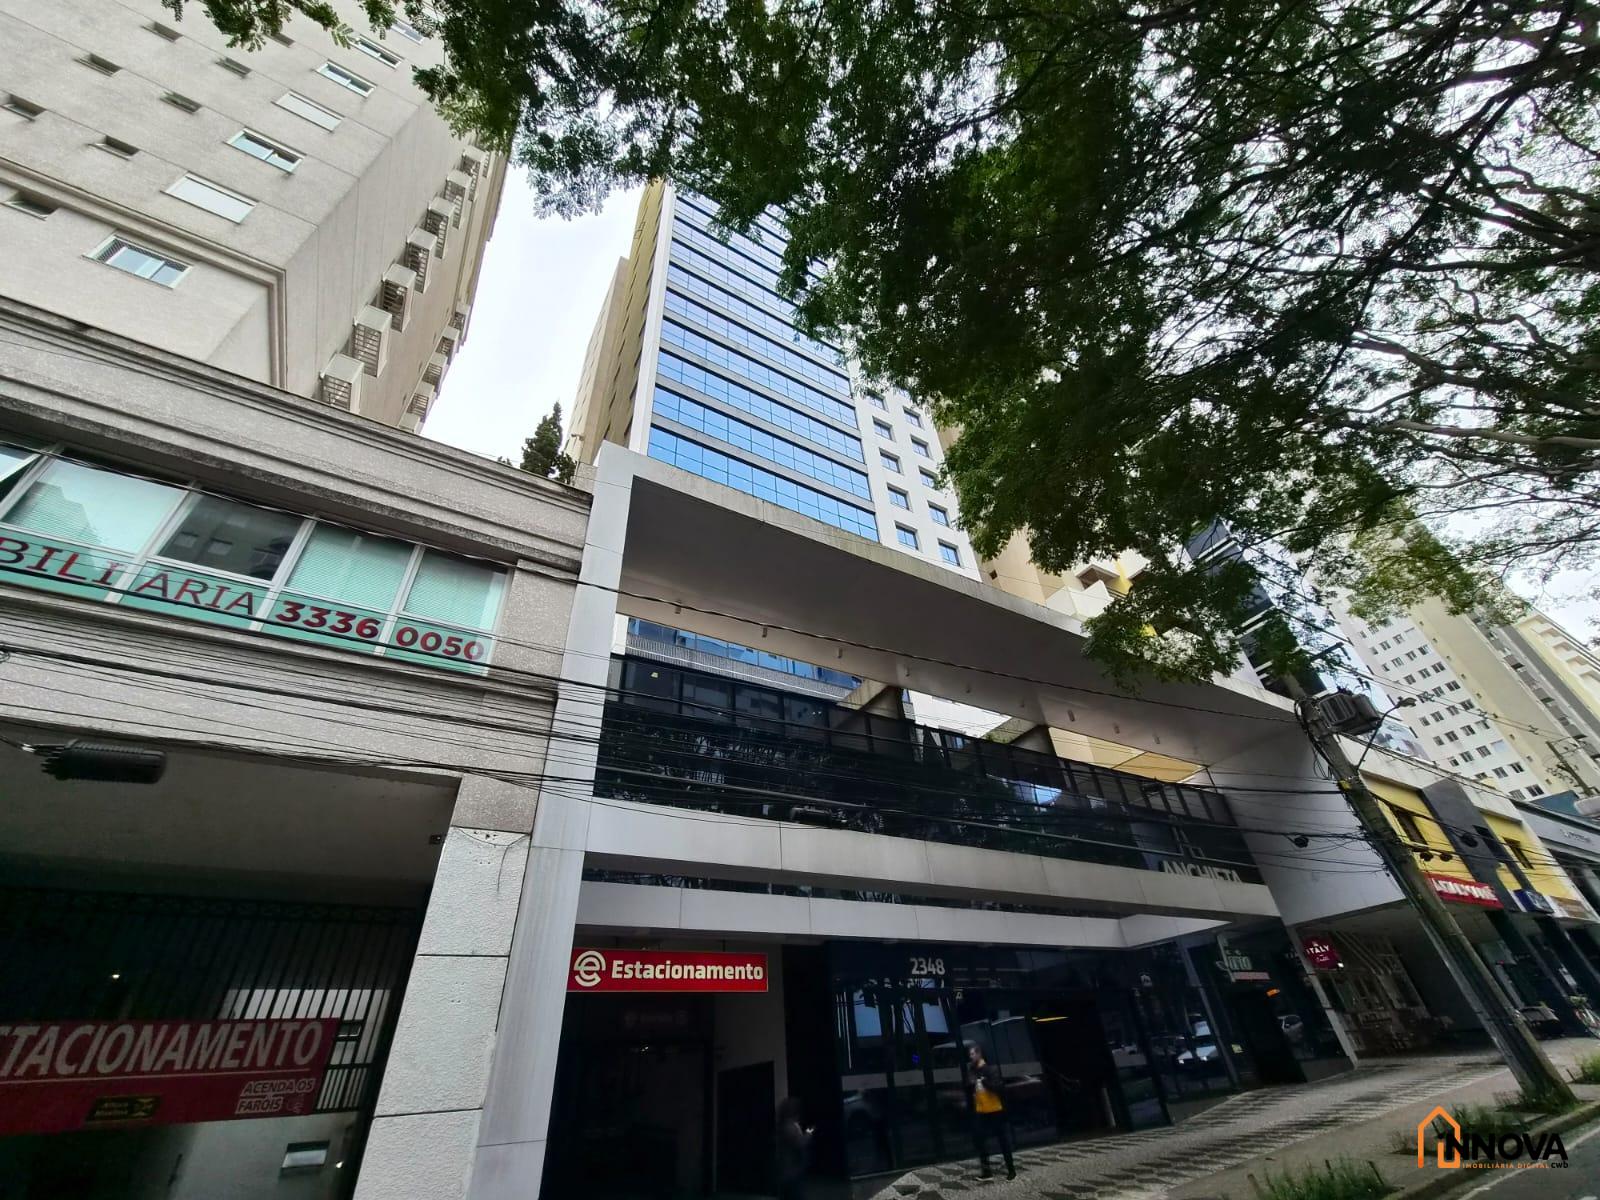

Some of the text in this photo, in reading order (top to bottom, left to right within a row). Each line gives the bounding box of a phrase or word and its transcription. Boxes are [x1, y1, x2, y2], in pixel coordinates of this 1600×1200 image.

[275, 600, 485, 662] 3336 0050
[611, 959, 764, 980] Estacionamento
[910, 958, 945, 976] 2348
